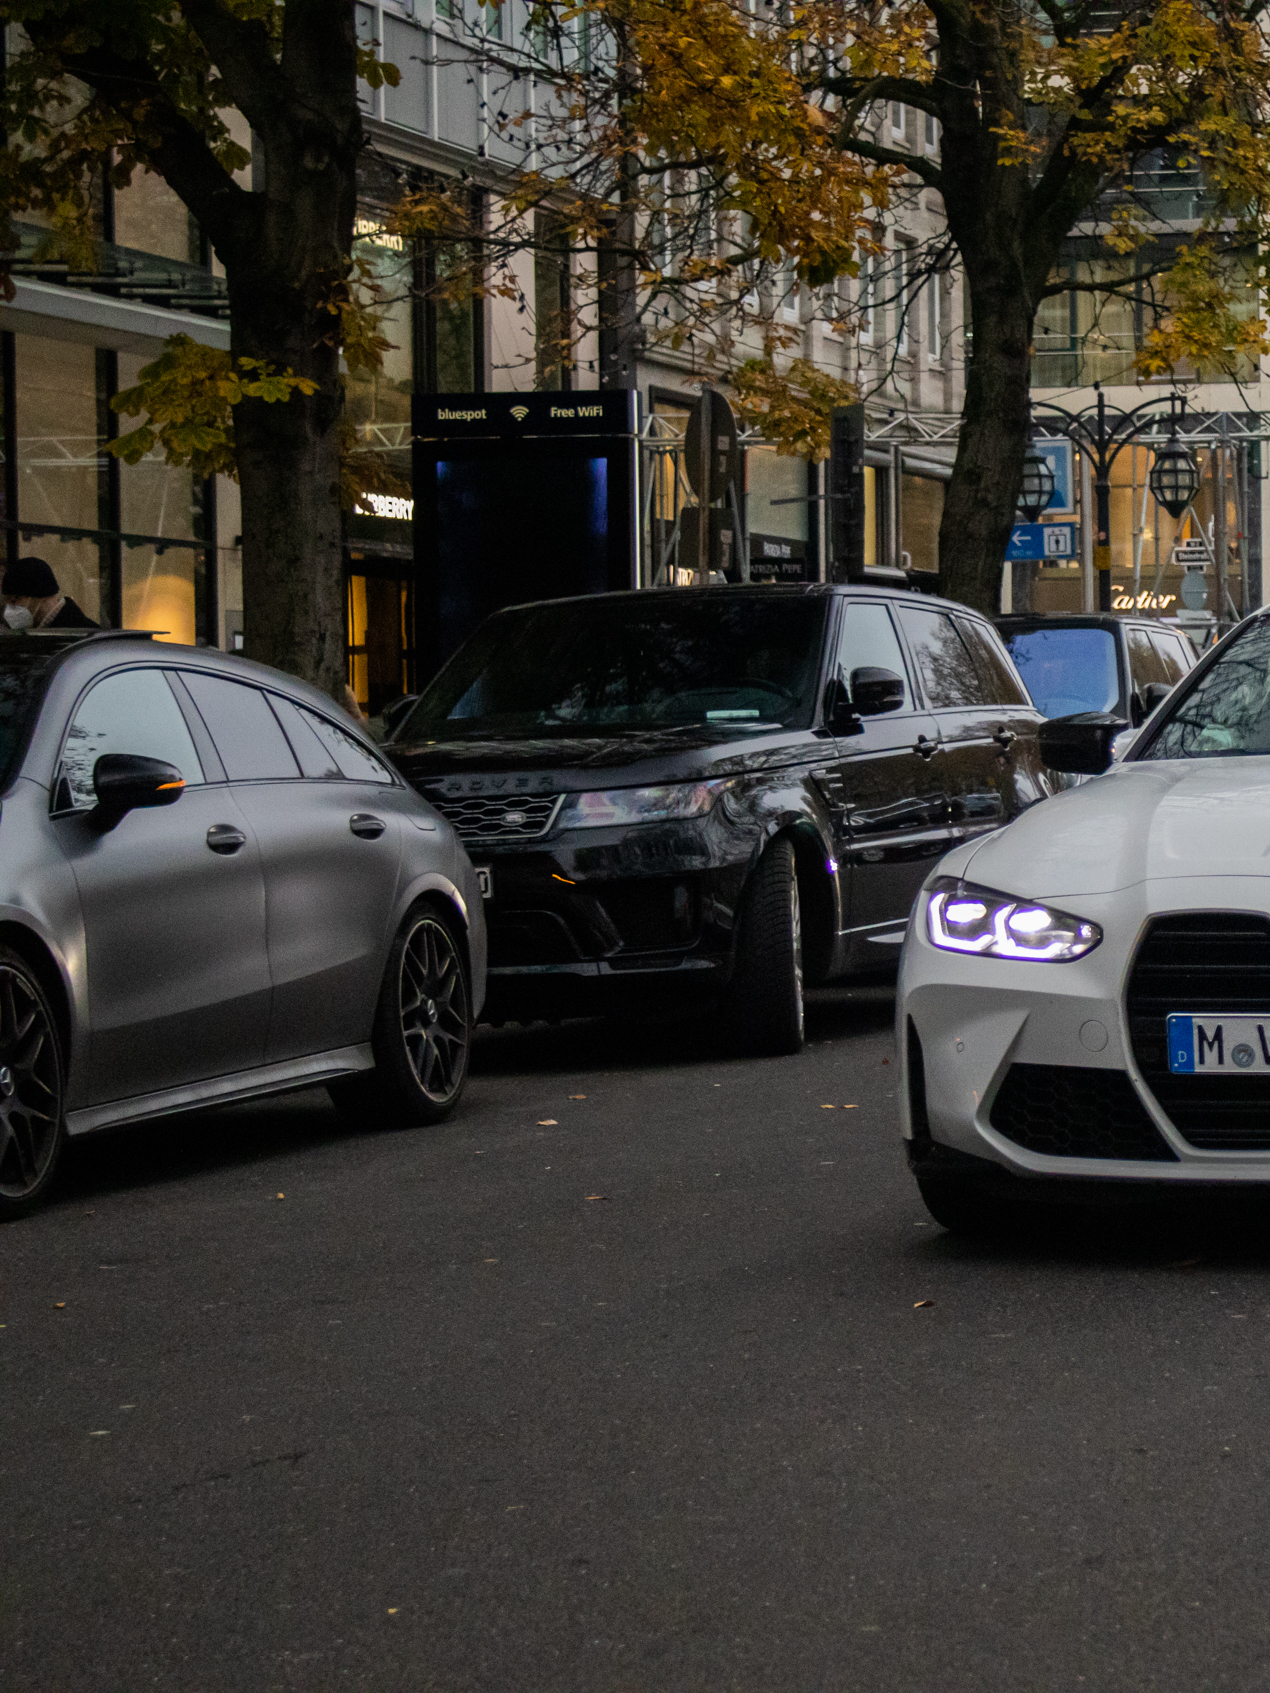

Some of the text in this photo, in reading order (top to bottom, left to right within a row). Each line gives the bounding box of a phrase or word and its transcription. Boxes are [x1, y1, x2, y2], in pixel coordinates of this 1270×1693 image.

[437, 408, 487, 422] bluespot
[550, 405, 603, 418] Free WiFi
[354, 492, 415, 521] RBERRY
[750, 563, 802, 574] ATRIZIA PEPE
[1110, 585, 1176, 609] Cartier
[1177, 1051, 1187, 1063] D
[1196, 1023, 1225, 1066] M
